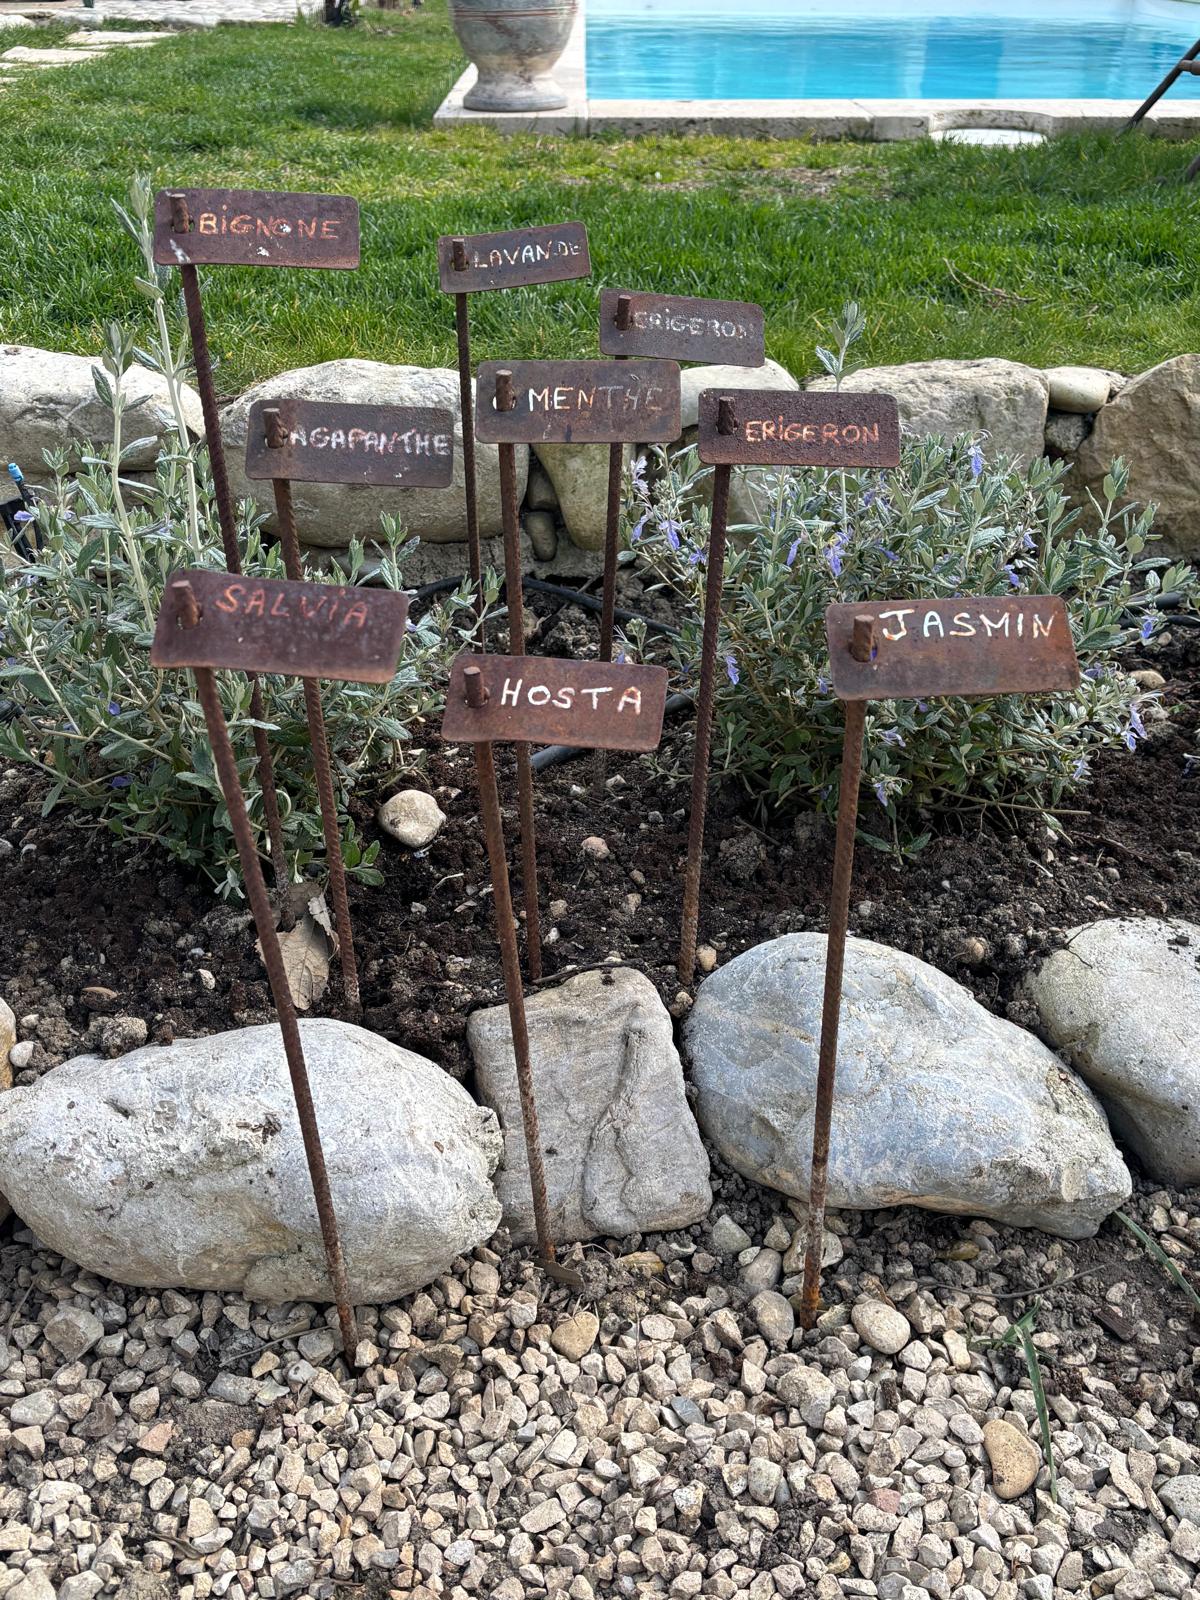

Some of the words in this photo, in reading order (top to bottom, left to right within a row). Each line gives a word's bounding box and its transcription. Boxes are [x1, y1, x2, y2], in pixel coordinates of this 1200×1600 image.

[473, 239, 582, 268] LAVANDE
[528, 385, 663, 412] MENTHE
[879, 608, 1055, 641] JASMIN
[500, 677, 642, 715] HOSTA
